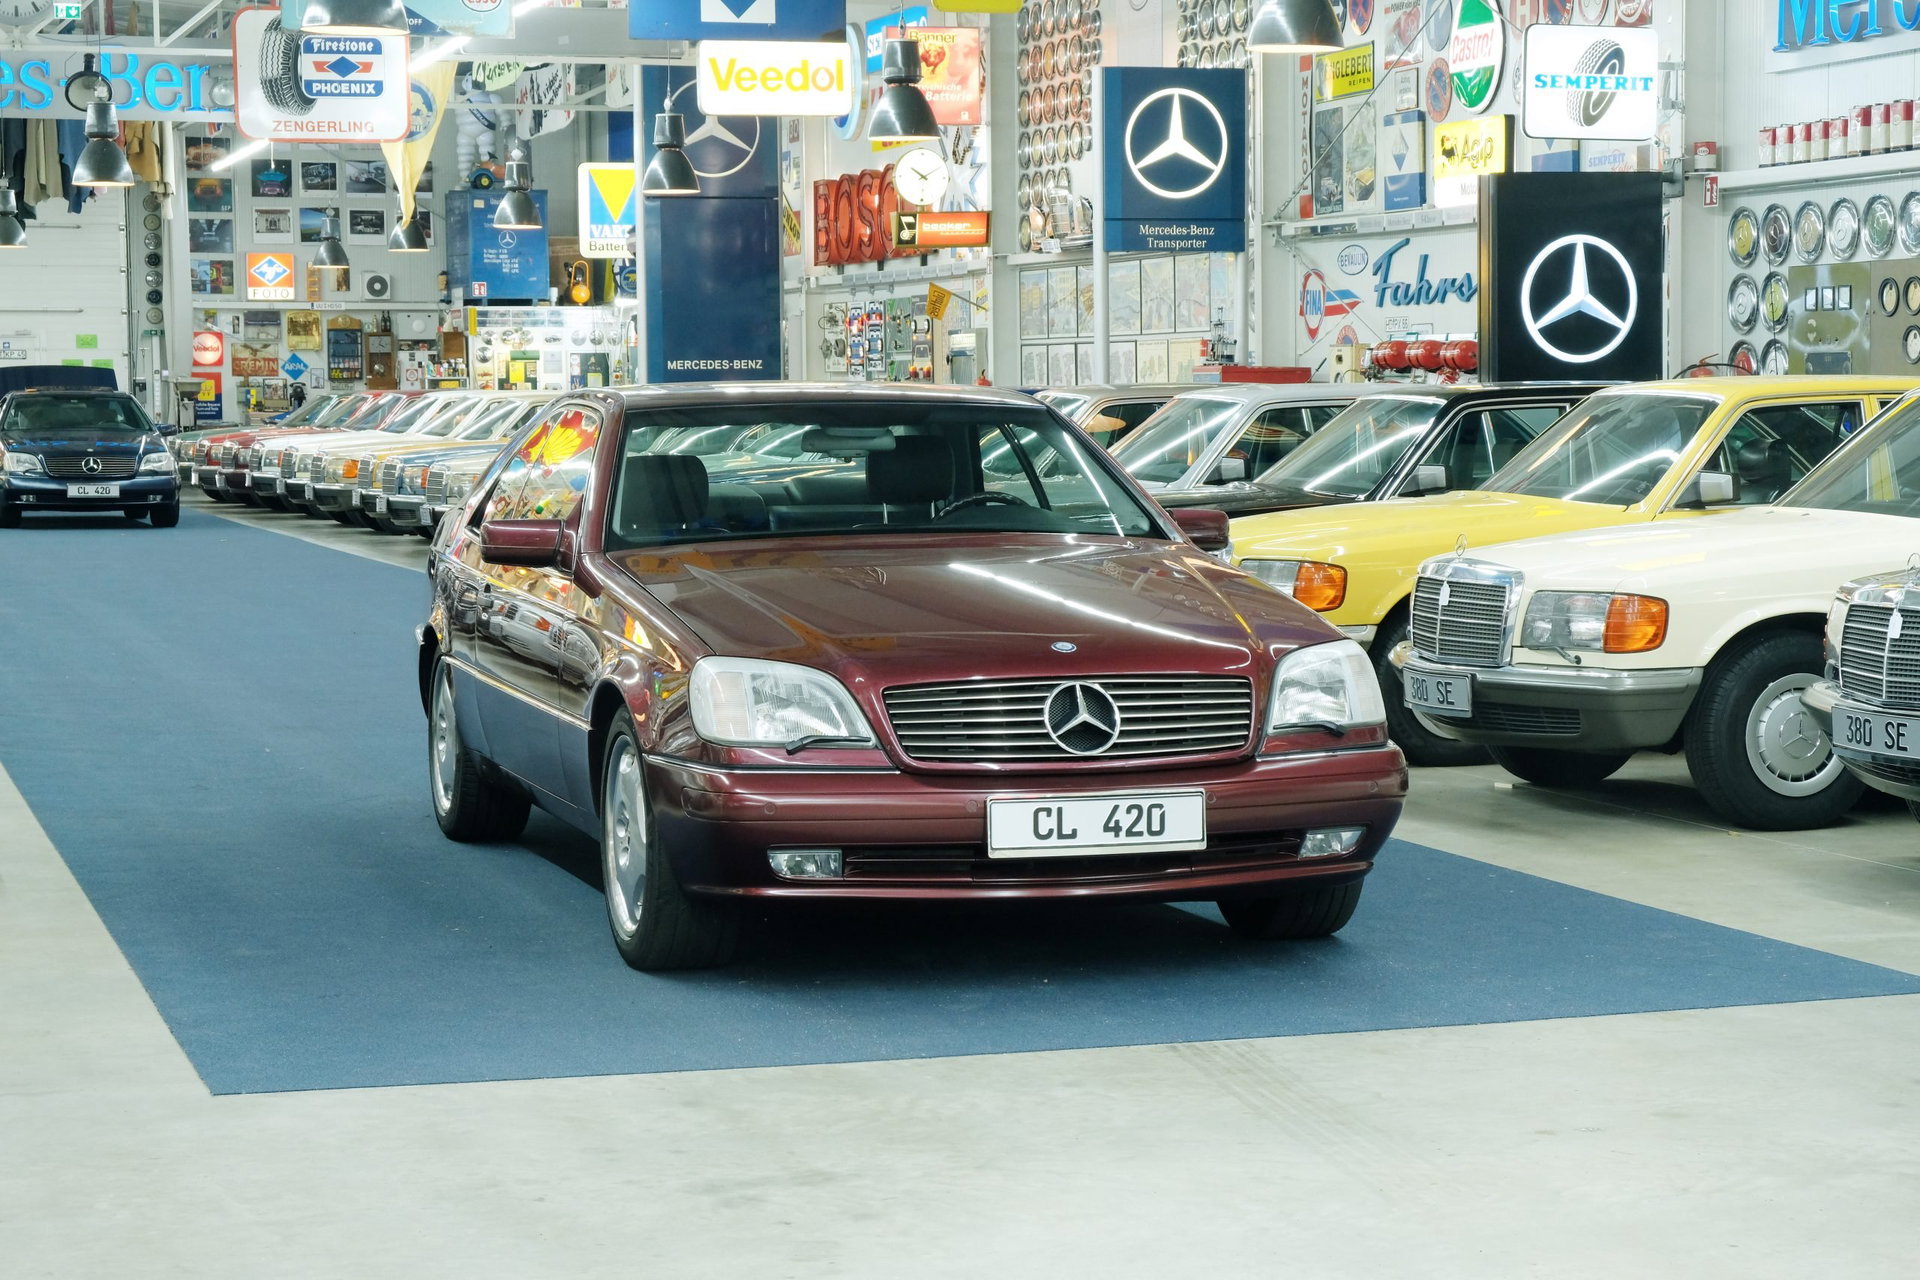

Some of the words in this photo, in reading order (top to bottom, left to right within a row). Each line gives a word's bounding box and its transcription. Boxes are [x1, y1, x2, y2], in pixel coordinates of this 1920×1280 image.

[909, 31, 957, 43] Banner
[311, 38, 374, 53] Firestone
[1452, 30, 1495, 64] Castrol
[708, 57, 844, 92] Veedol
[1349, 77, 1371, 86] REIFEN
[312, 82, 375, 96] PHOENIX
[1535, 74, 1653, 92] SEMPERIT
[273, 120, 375, 134] ZENGERLING
[1459, 136, 1496, 170] Agip
[1461, 183, 1476, 196] Moto
[815, 164, 938, 266] BOSC
[590, 225, 636, 238] VART
[1139, 225, 1215, 237] Mercedes-Benz
[590, 240, 625, 251] Batter
[1147, 238, 1207, 249] Transporter
[1372, 238, 1477, 308] Fahrs
[253, 289, 289, 298] FOTO
[284, 361, 306, 371] ARAL
[667, 359, 763, 370] MERCEDES-BENZ
[77, 486, 89, 495] CL
[95, 486, 111, 495] 420
[1411, 676, 1429, 702] 380
[1436, 680, 1455, 705] SE
[1846, 715, 1873, 747] 380
[1885, 721, 1908, 752] SE
[1033, 807, 1078, 840] CL
[1103, 803, 1166, 838] 420
